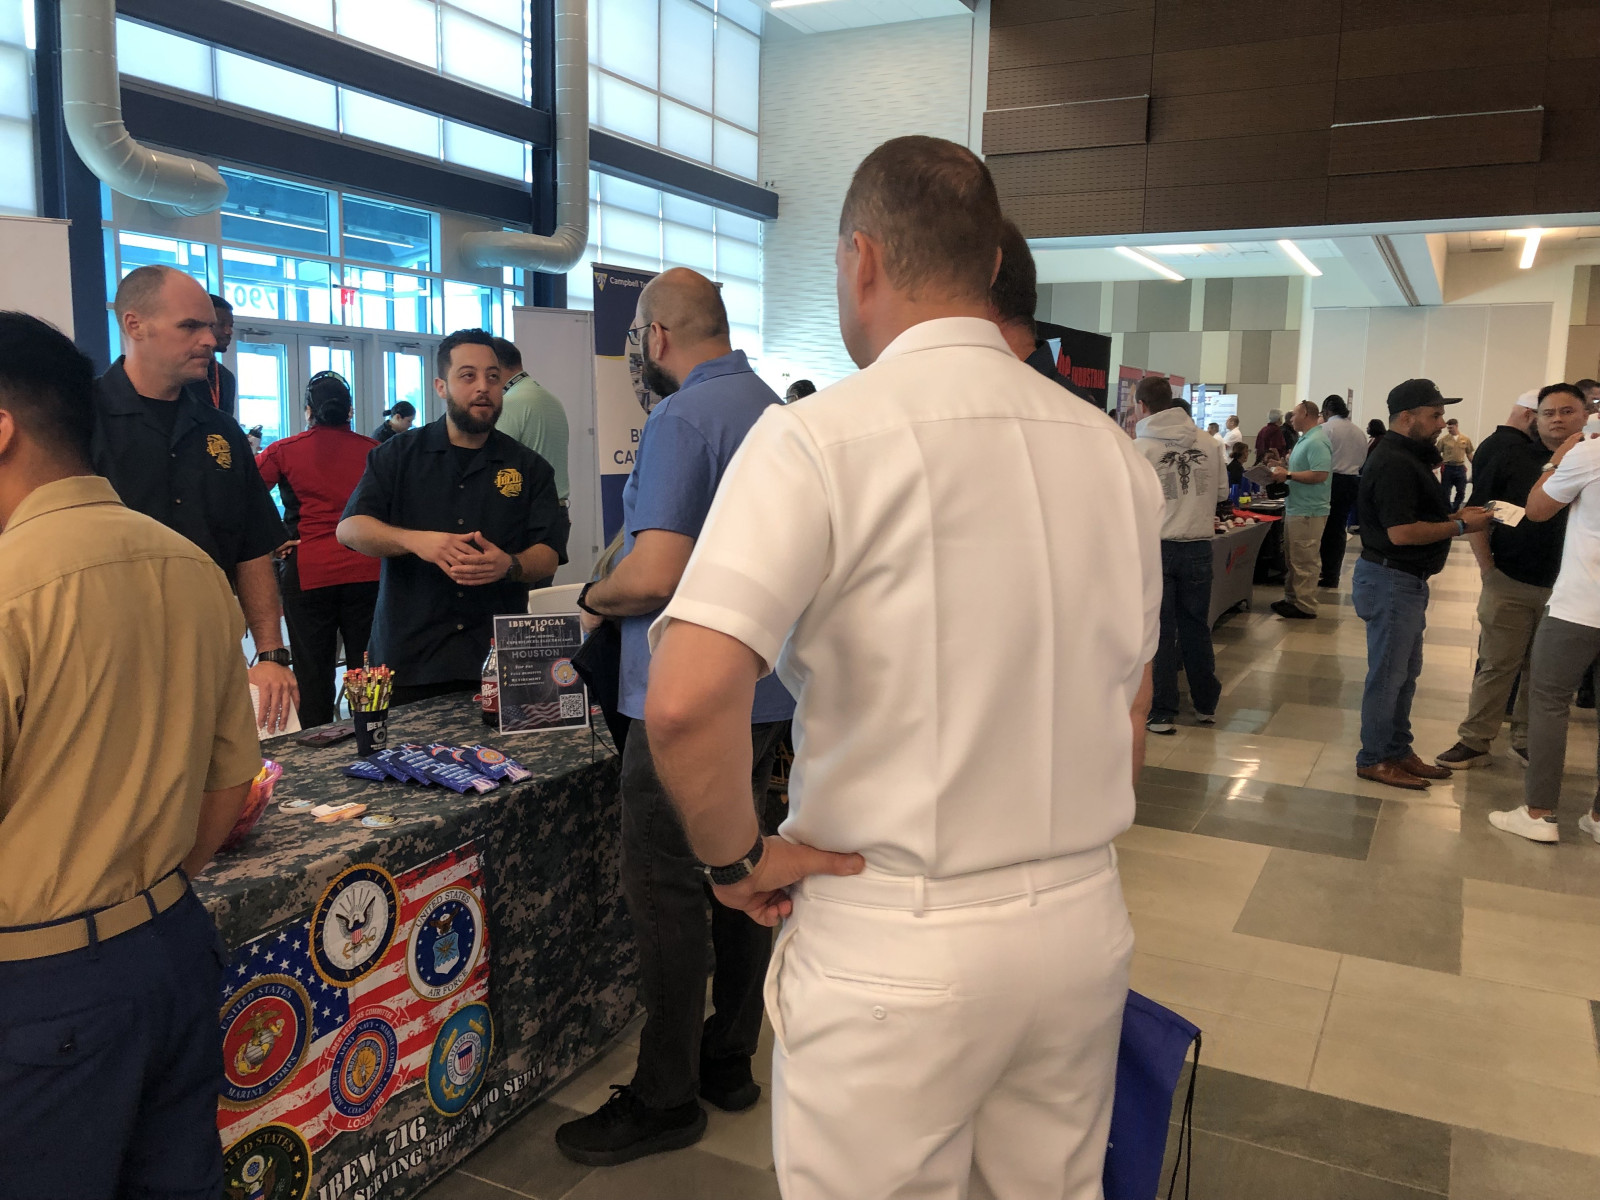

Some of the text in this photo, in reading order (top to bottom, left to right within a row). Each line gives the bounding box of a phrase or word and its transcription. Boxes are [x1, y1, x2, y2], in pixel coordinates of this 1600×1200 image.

[609, 276, 640, 288] Campbell
[508, 618, 566, 628] IBEW LOCAL
[512, 649, 560, 659] HOUSTON
[415, 890, 471, 928] UNITED STATES
[427, 968, 468, 997] AIR FORCE
[220, 985, 292, 1030] UNITED STATES
[365, 1007, 394, 1020] COMMITTEE
[227, 1055, 298, 1099] MARINE CORPS
[347, 1112, 373, 1129] LOCAL
[255, 1133, 296, 1153] STATES
[353, 1147, 423, 1200] SERVING
[426, 1113, 468, 1156] THOSE
[471, 1087, 500, 1119] WHO
[317, 1116, 427, 1200] IBEW 716
